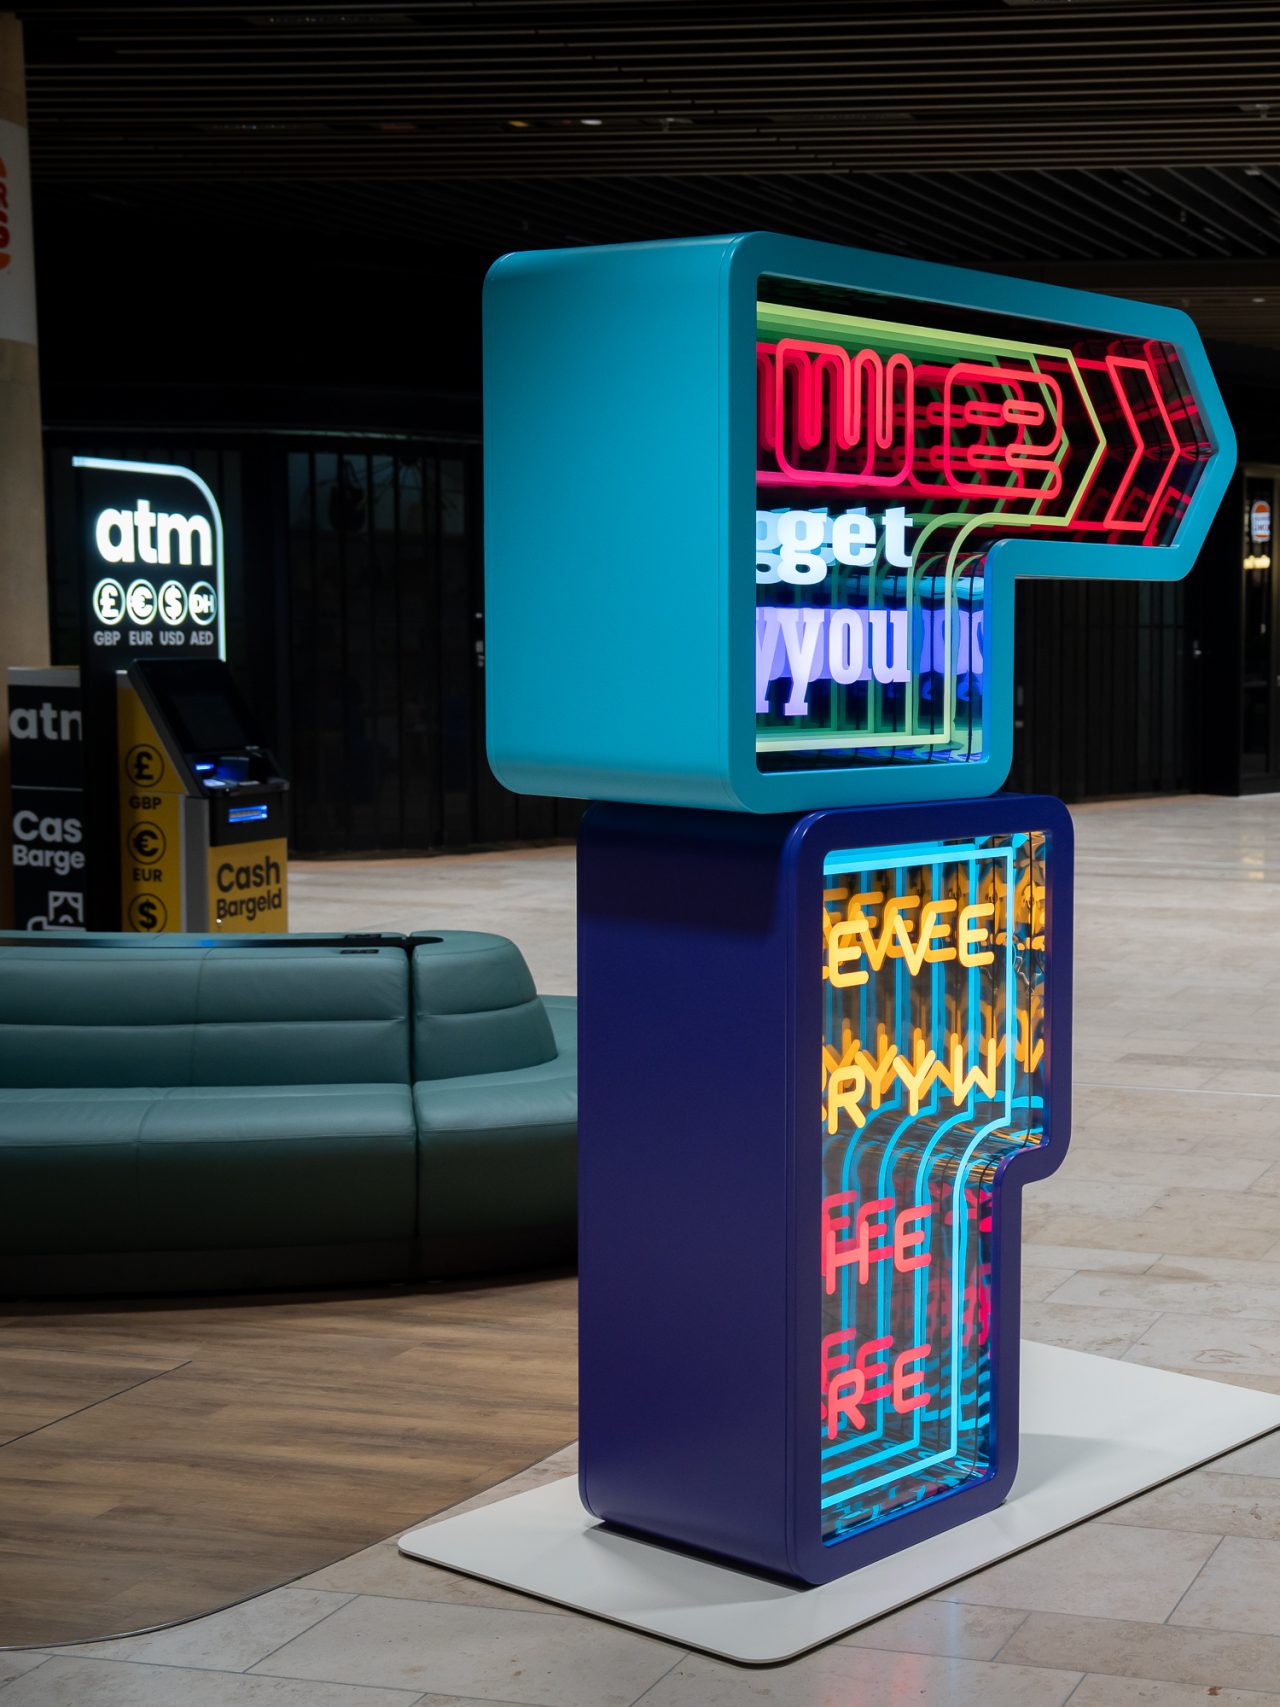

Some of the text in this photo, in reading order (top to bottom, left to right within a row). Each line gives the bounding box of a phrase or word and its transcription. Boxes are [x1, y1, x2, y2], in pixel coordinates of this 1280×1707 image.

[95, 499, 213, 566] atm
[94, 631, 214, 646] GBP EUR USD AED
[128, 795, 162, 810] GBP
[133, 868, 163, 883] EUR
[217, 856, 280, 893] Cash
[217, 888, 281, 921] Bargeld
